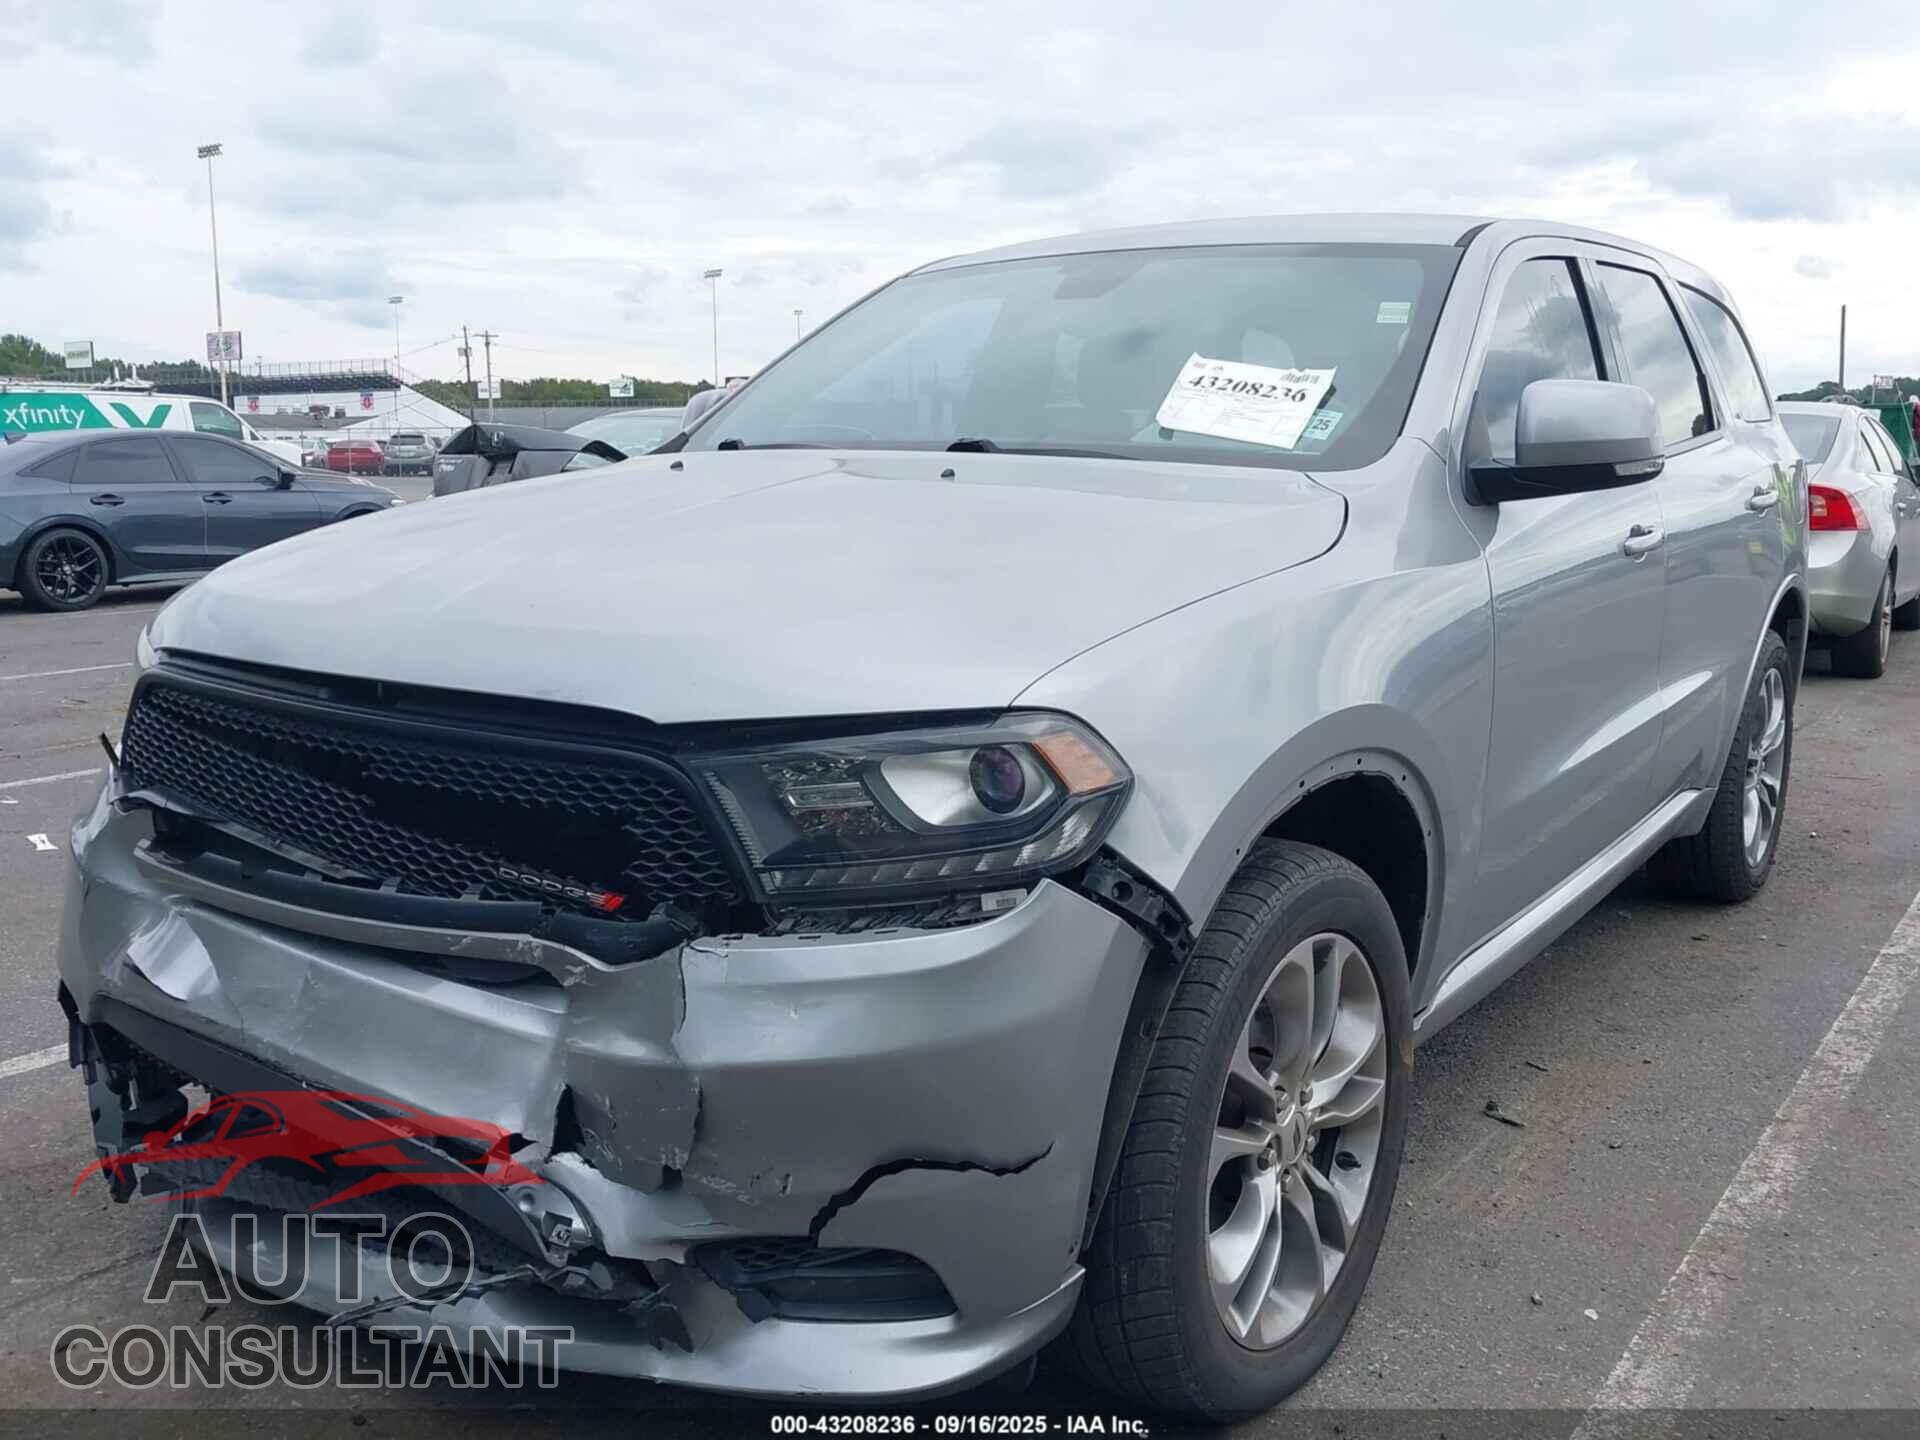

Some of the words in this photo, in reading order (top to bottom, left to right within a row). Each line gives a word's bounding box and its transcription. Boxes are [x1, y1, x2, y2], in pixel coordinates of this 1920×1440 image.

[1189, 375, 1308, 403] 43208236
[3, 402, 85, 430] xfinity
[1311, 418, 1332, 431] 25
[499, 866, 607, 911] DODGE
